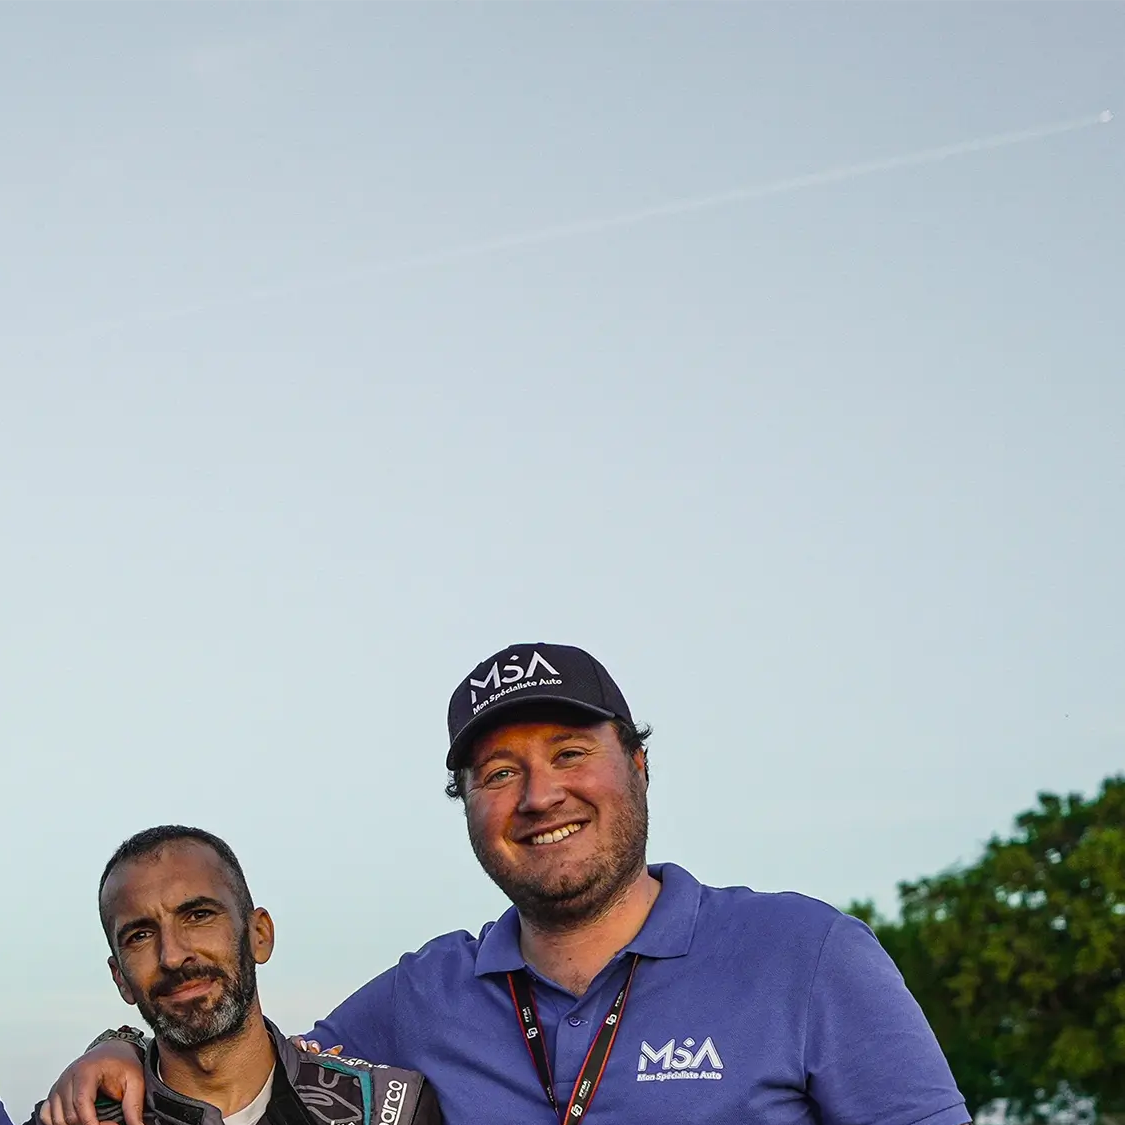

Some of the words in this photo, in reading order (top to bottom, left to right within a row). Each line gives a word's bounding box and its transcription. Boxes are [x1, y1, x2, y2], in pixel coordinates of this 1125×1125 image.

[470, 651, 560, 704] MSA
[472, 699, 489, 715] Mon
[489, 681, 537, 703] Spécialiste
[538, 678, 563, 686] Auto
[638, 1036, 724, 1072] MSA
[637, 1073, 655, 1082] Mon
[699, 1070, 722, 1080] Auto
